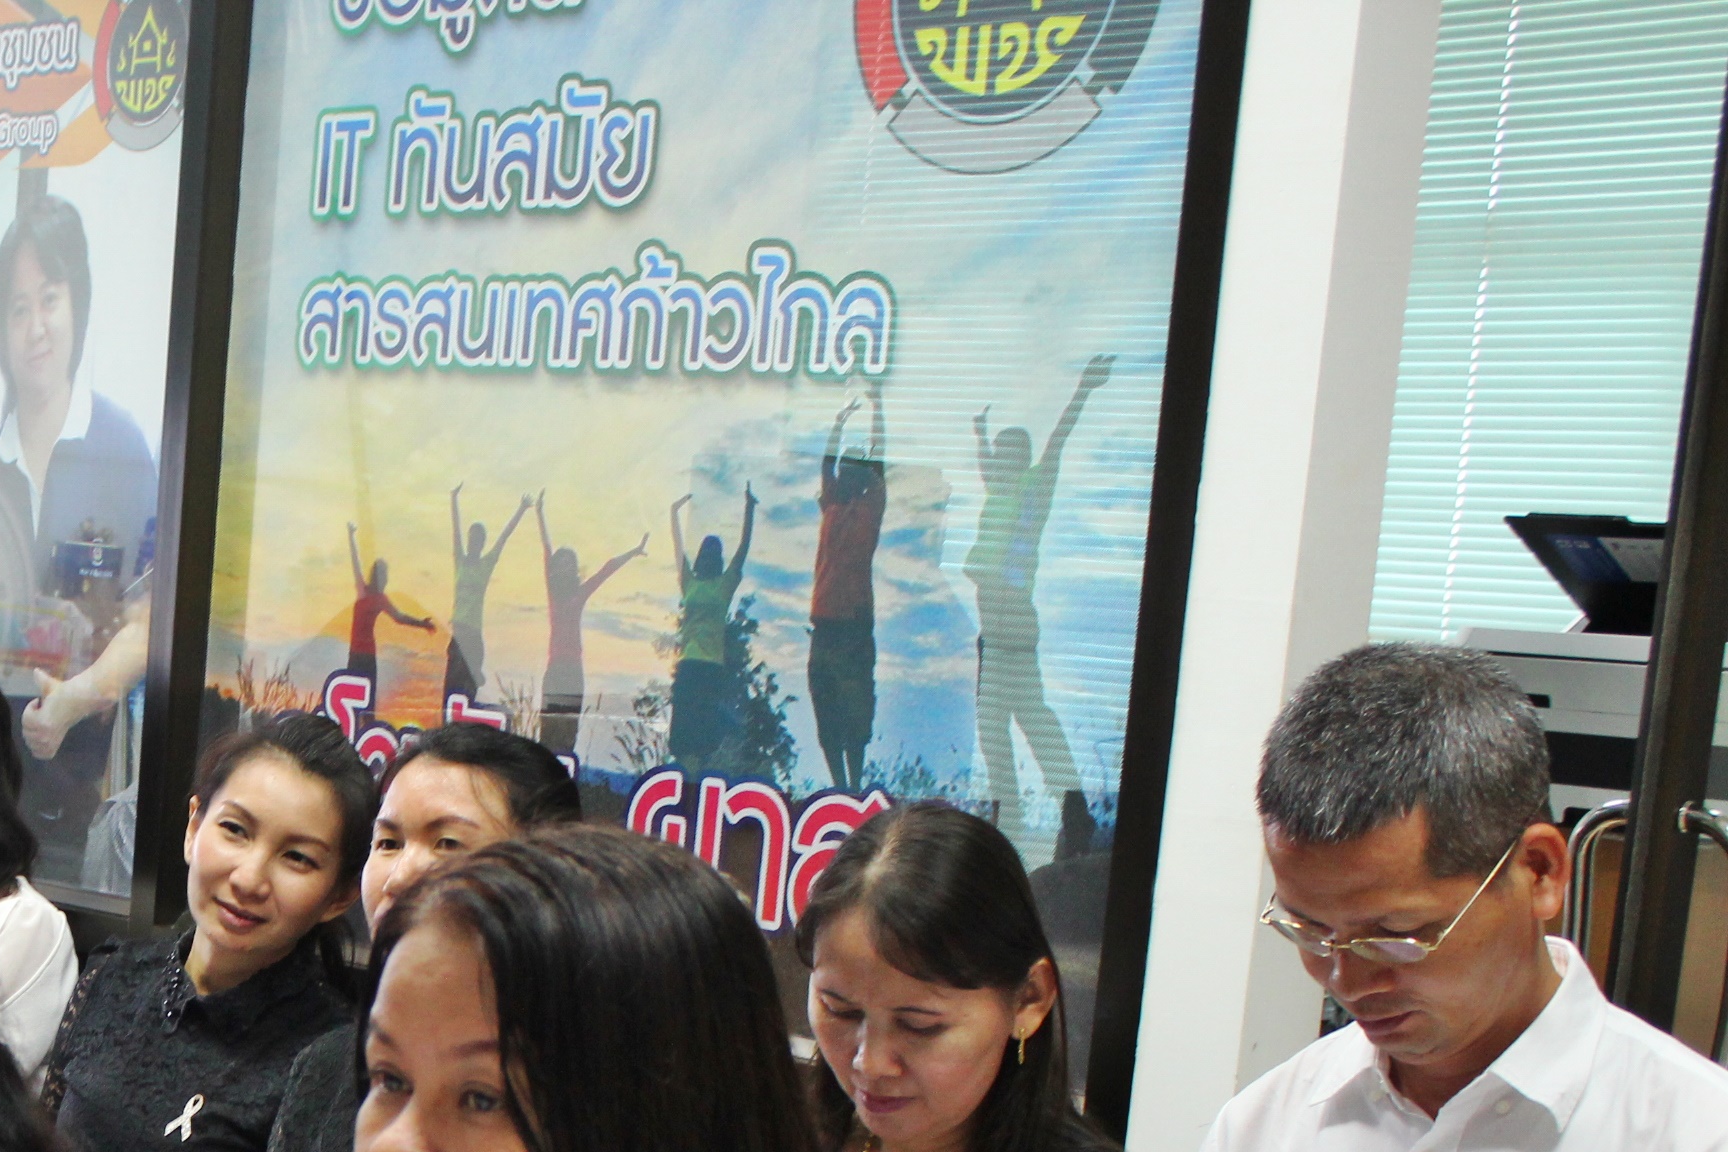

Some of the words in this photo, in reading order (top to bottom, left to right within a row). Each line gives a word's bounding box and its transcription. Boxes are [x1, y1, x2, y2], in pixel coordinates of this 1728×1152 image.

[315, 113, 374, 212] IT
[388, 80, 654, 212] ทันสมัย
[300, 251, 892, 373] สารสนเทศก้าวไกล
